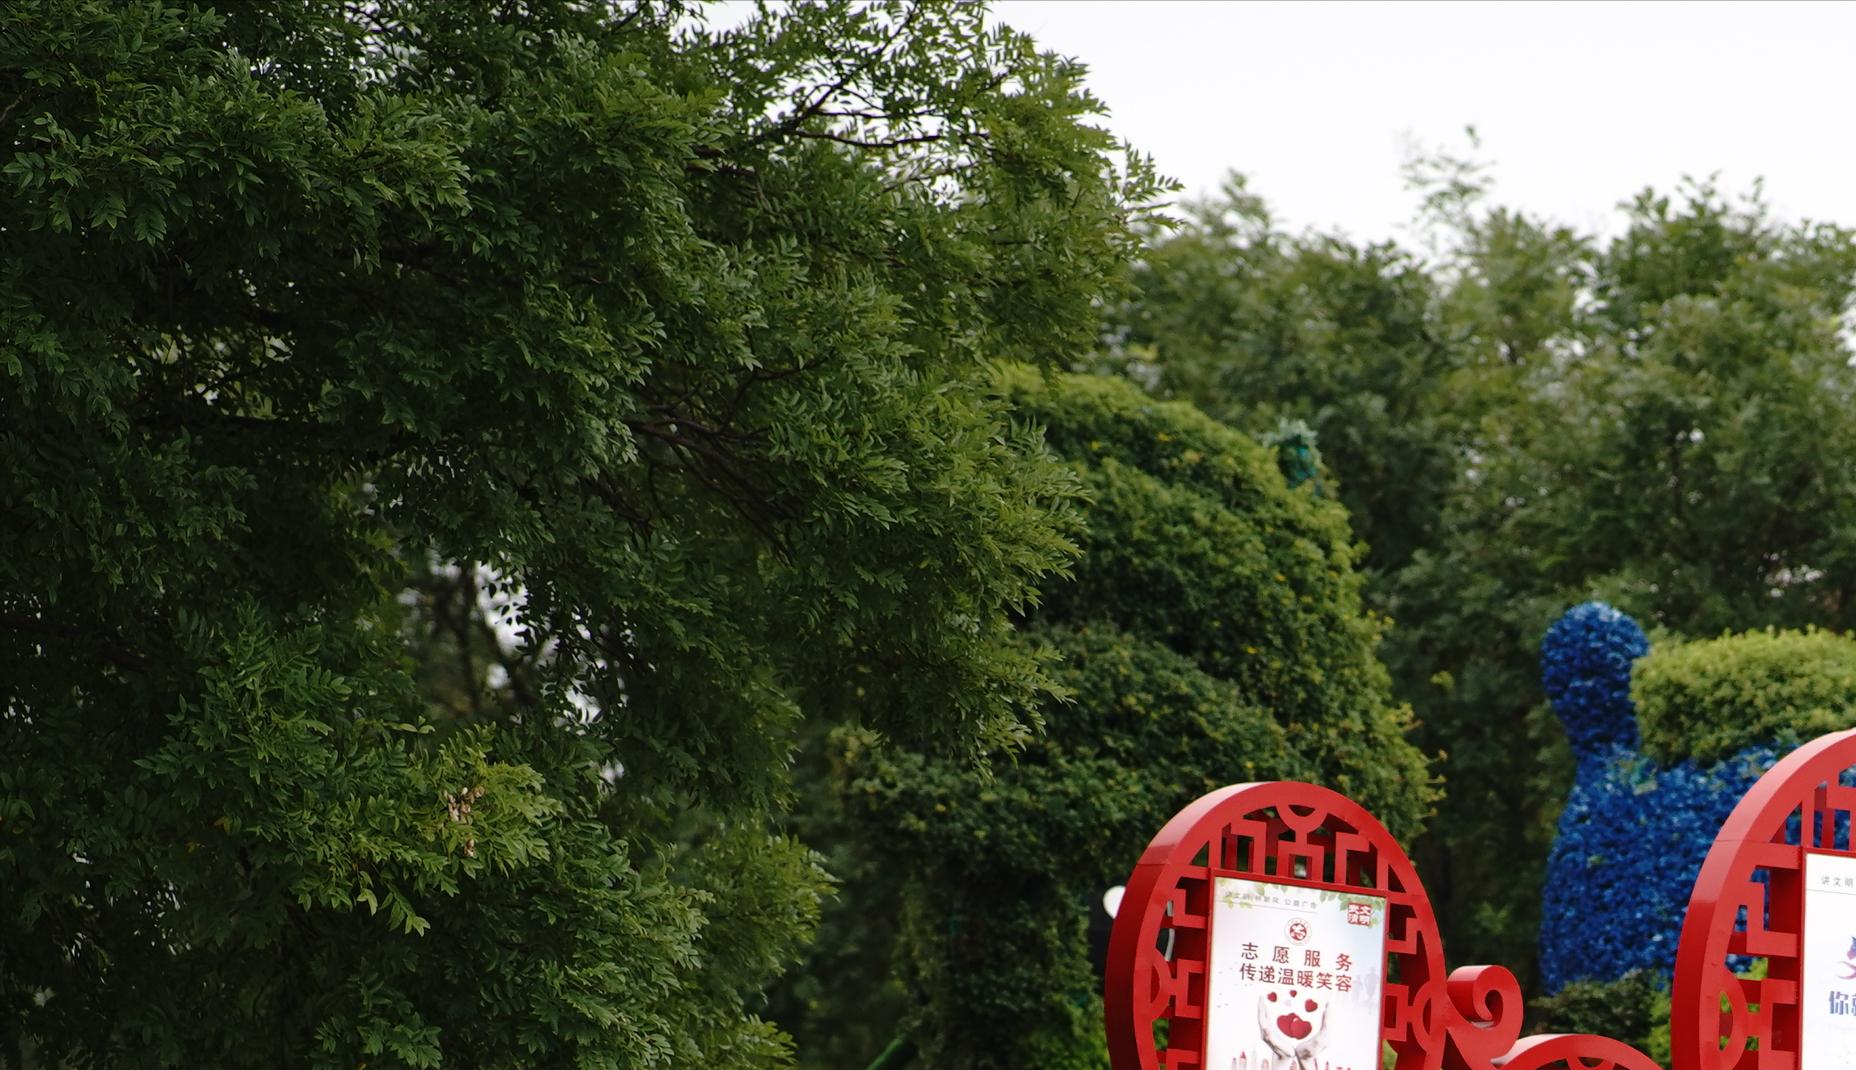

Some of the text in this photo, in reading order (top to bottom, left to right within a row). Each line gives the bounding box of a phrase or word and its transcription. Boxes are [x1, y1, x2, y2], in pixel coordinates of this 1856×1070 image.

[1241, 942, 1353, 972] 志愿服务
[1240, 963, 1352, 992] 传递温暖笑容
